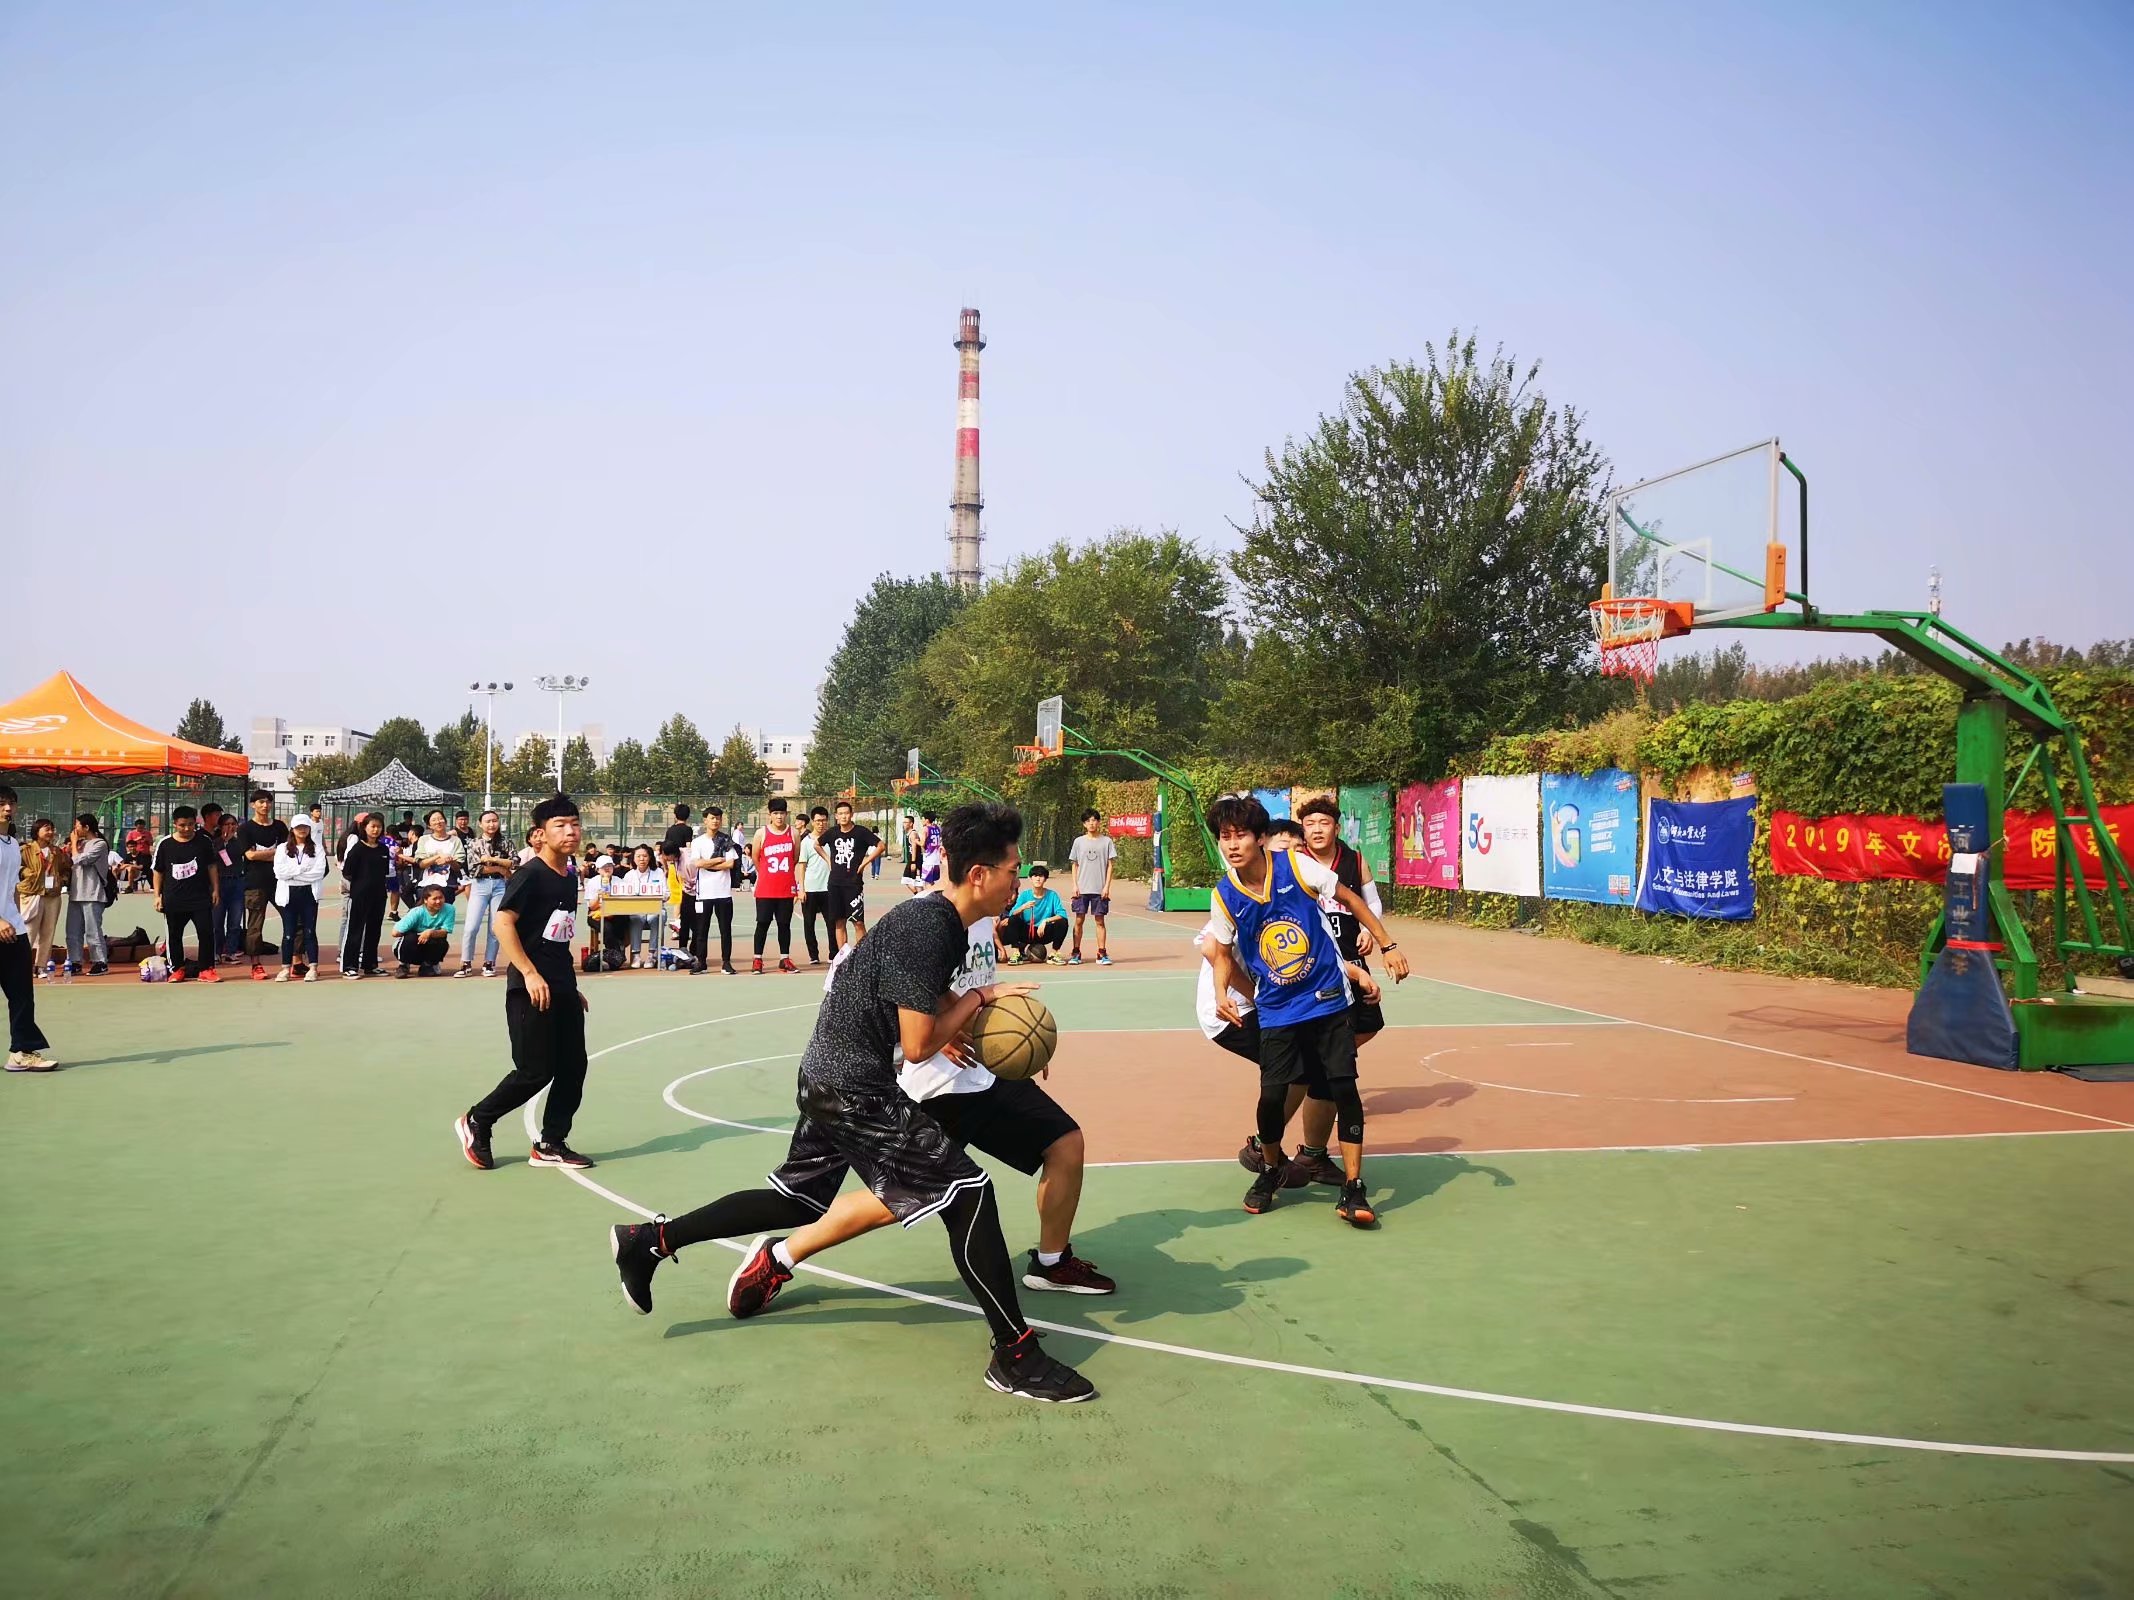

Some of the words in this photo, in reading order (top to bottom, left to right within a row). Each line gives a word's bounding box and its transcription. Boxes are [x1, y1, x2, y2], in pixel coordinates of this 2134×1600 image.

[1468, 813, 1492, 855] 5G
[767, 857, 790, 873] 34
[613, 884, 633, 894] 010
[641, 884, 662, 894] 014
[1652, 866, 1739, 891] 人文与法律学院
[1280, 915, 1303, 927] STATE
[1274, 928, 1299, 950] 30
[1267, 957, 1315, 986] WARRIORS
